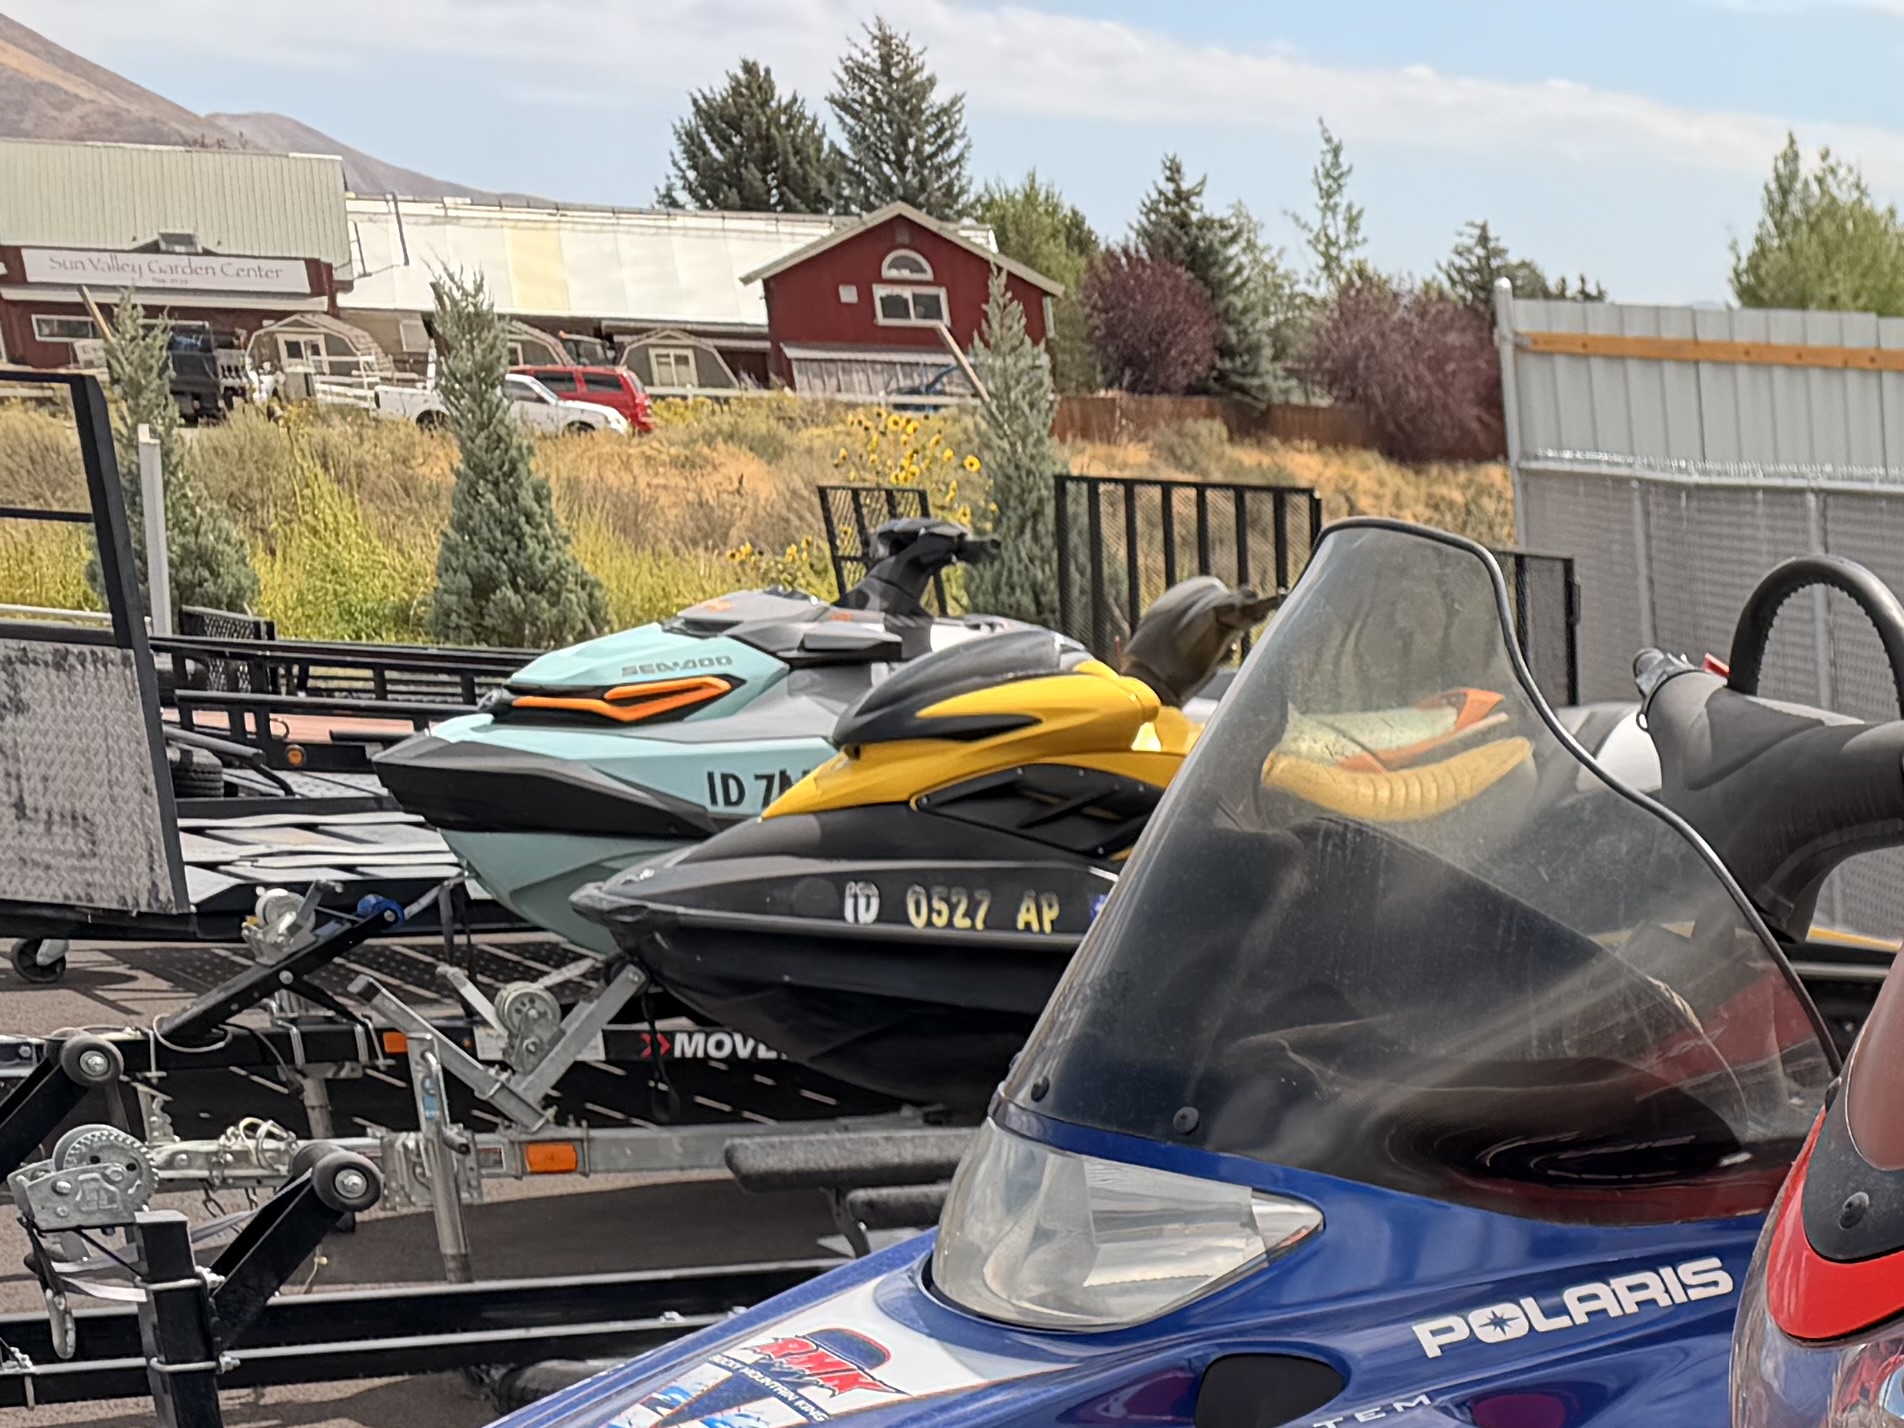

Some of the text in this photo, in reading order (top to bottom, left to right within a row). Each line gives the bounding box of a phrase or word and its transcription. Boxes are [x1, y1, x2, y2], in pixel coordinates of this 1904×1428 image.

[50, 253, 284, 279] Sun Valley Garden Center
[707, 771, 746, 807] ID
[843, 880, 1060, 934] ID 0527 AP
[673, 1032, 788, 1060] MOV
[1412, 1256, 1734, 1358] POLARIS
